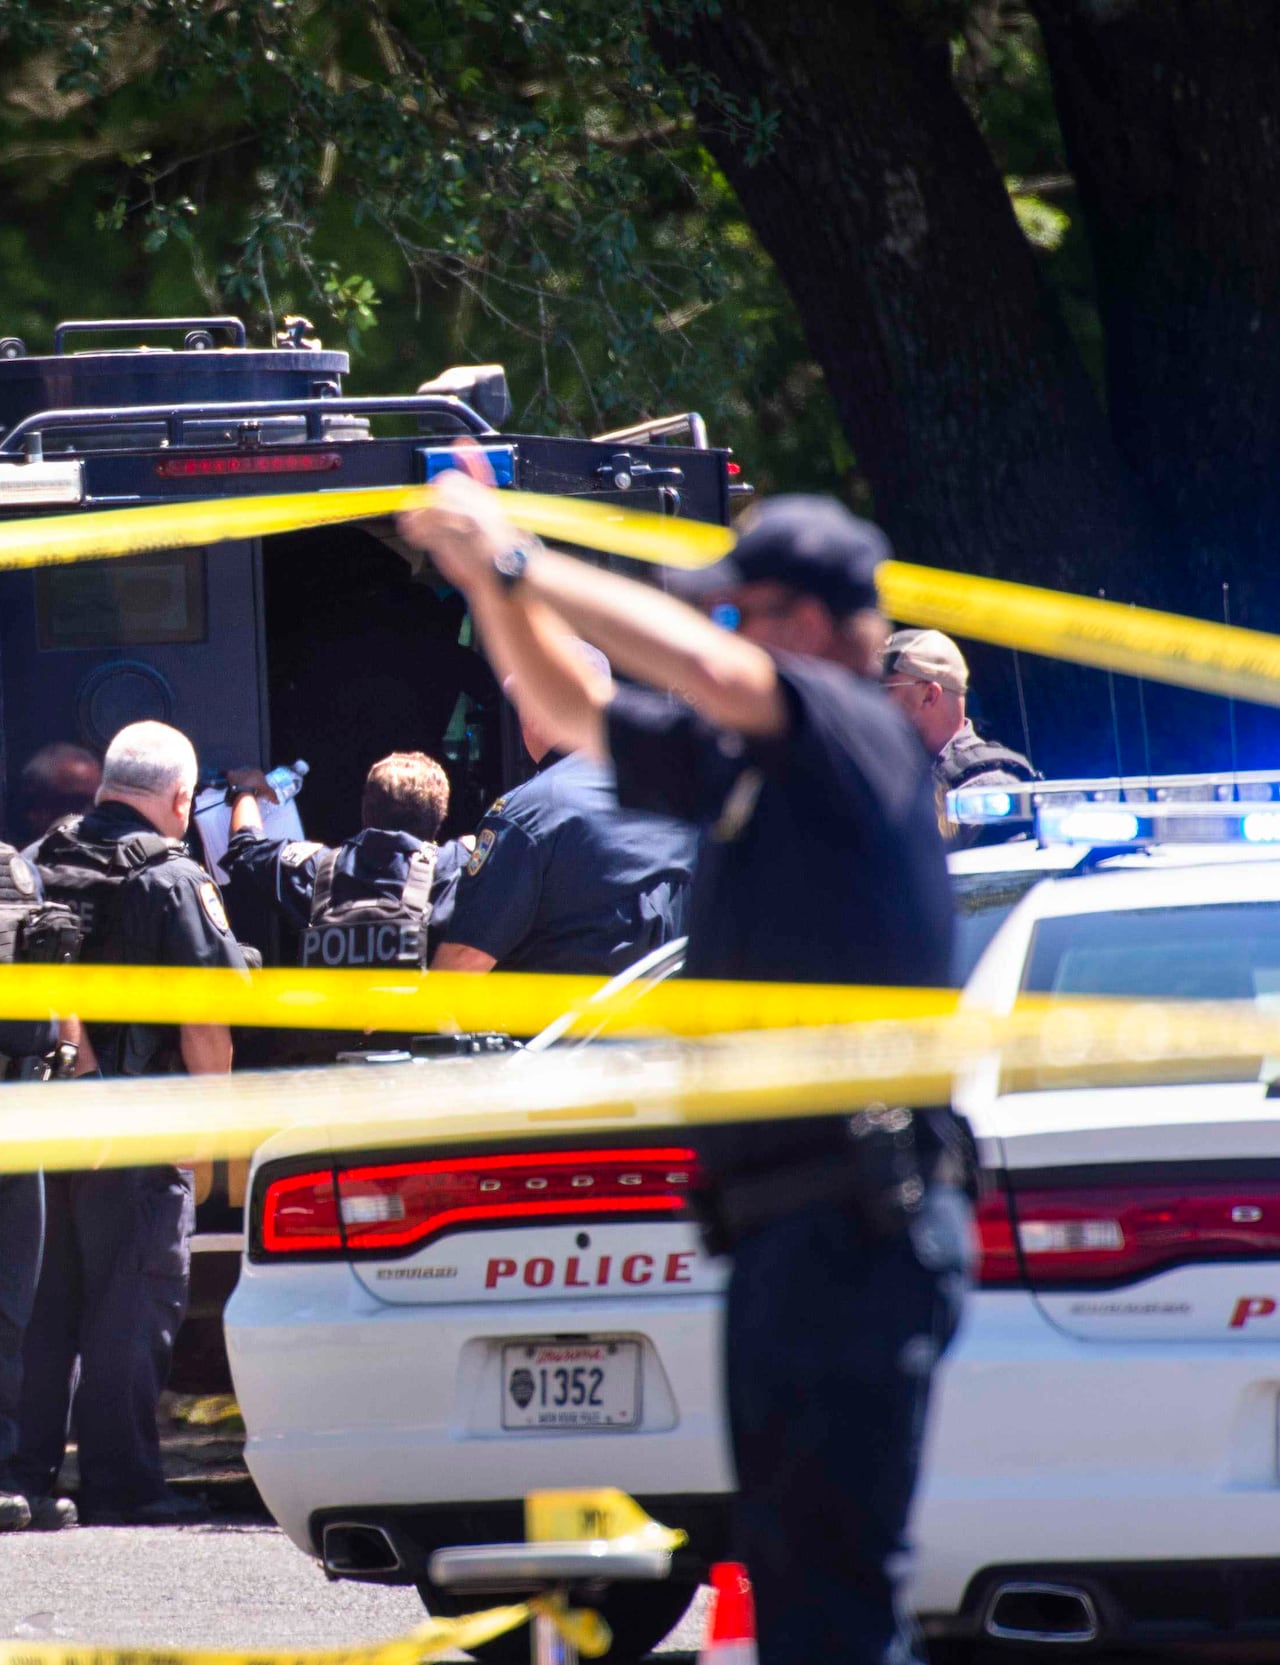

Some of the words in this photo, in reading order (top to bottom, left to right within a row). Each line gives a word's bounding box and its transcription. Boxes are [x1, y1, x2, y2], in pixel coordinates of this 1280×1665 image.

[303, 924, 420, 967] POLICE
[480, 1172, 690, 1191] DODGE
[484, 1252, 697, 1289] POLICE
[539, 1367, 604, 1406] 1352
